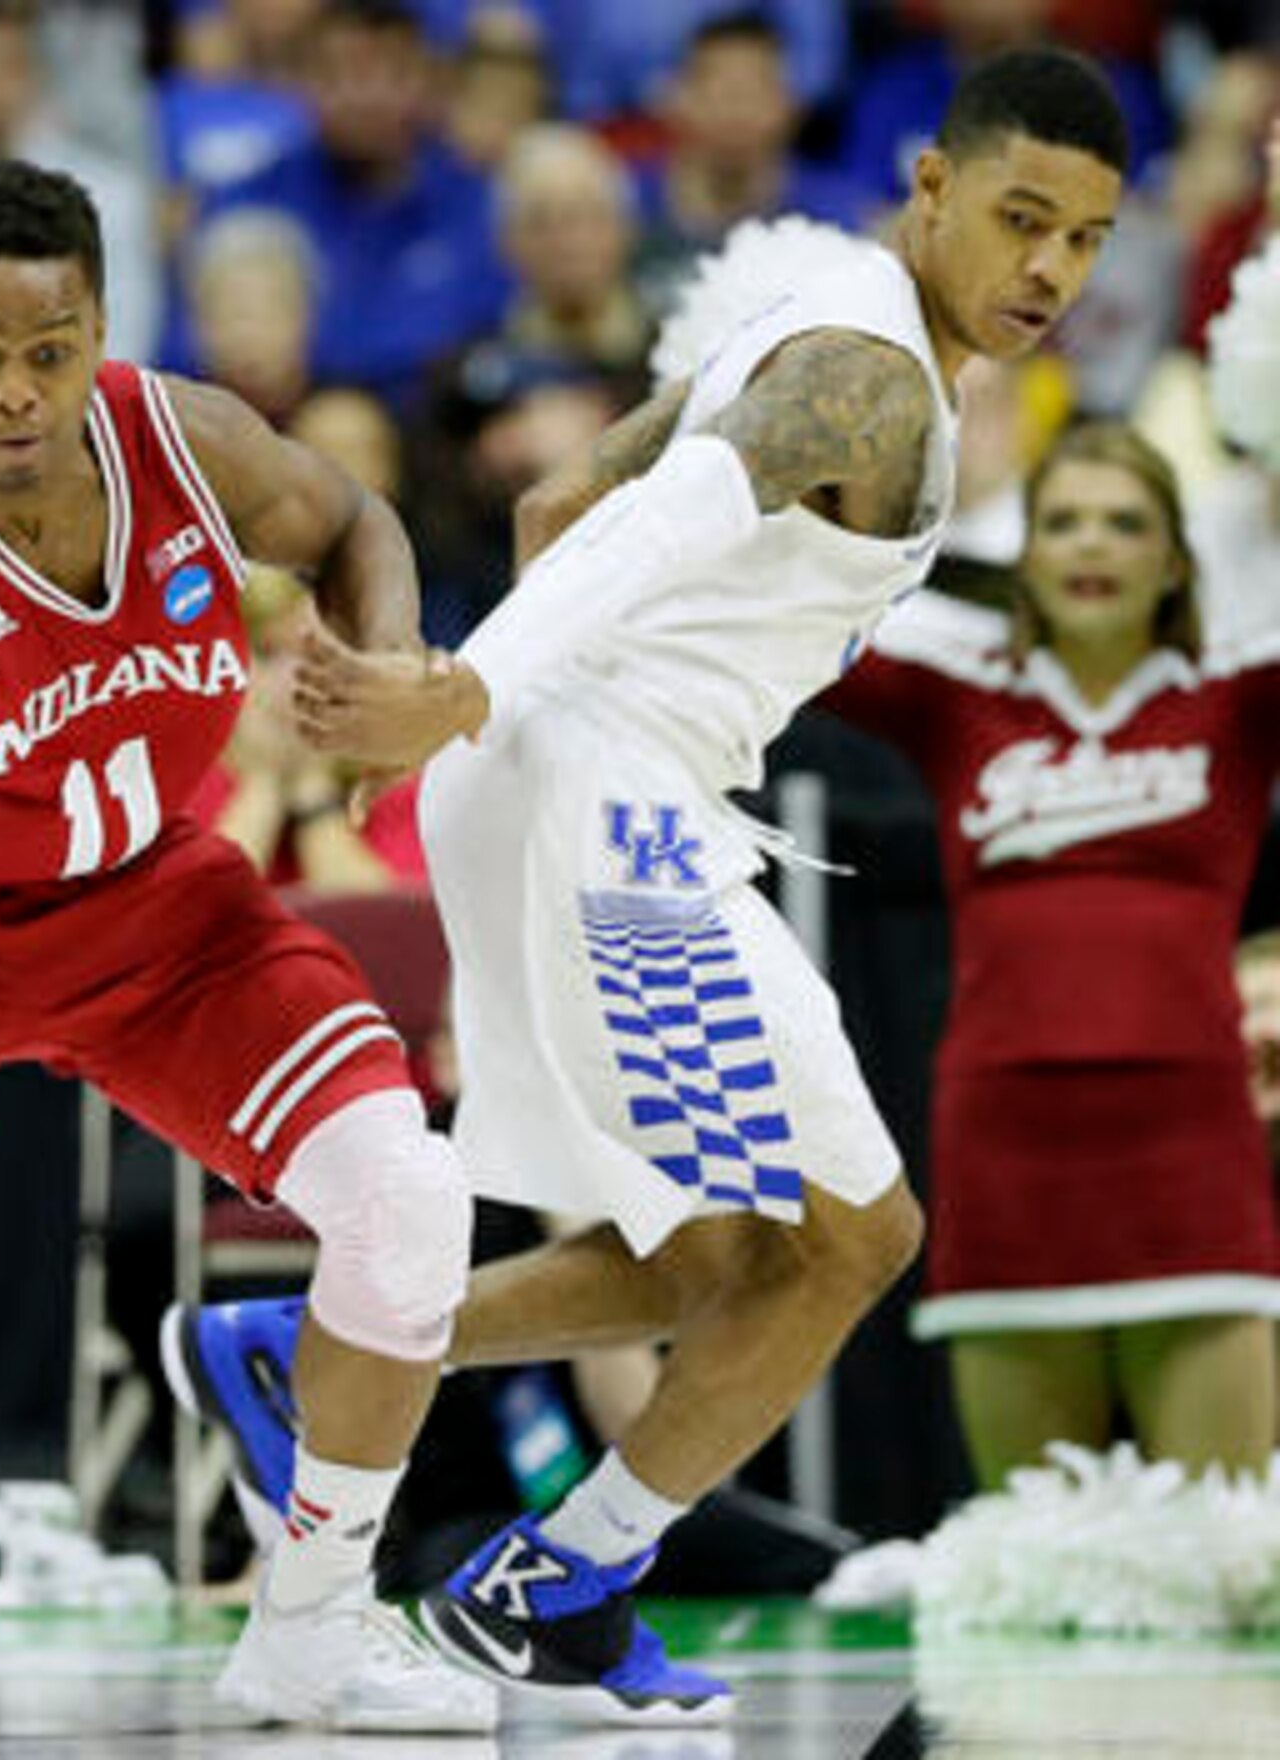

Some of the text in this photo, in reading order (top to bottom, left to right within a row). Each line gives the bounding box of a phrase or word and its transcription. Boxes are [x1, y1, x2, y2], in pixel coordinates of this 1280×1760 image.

[61, 737, 161, 880] 11
[601, 801, 708, 888] UK
[471, 1534, 567, 1619] K
